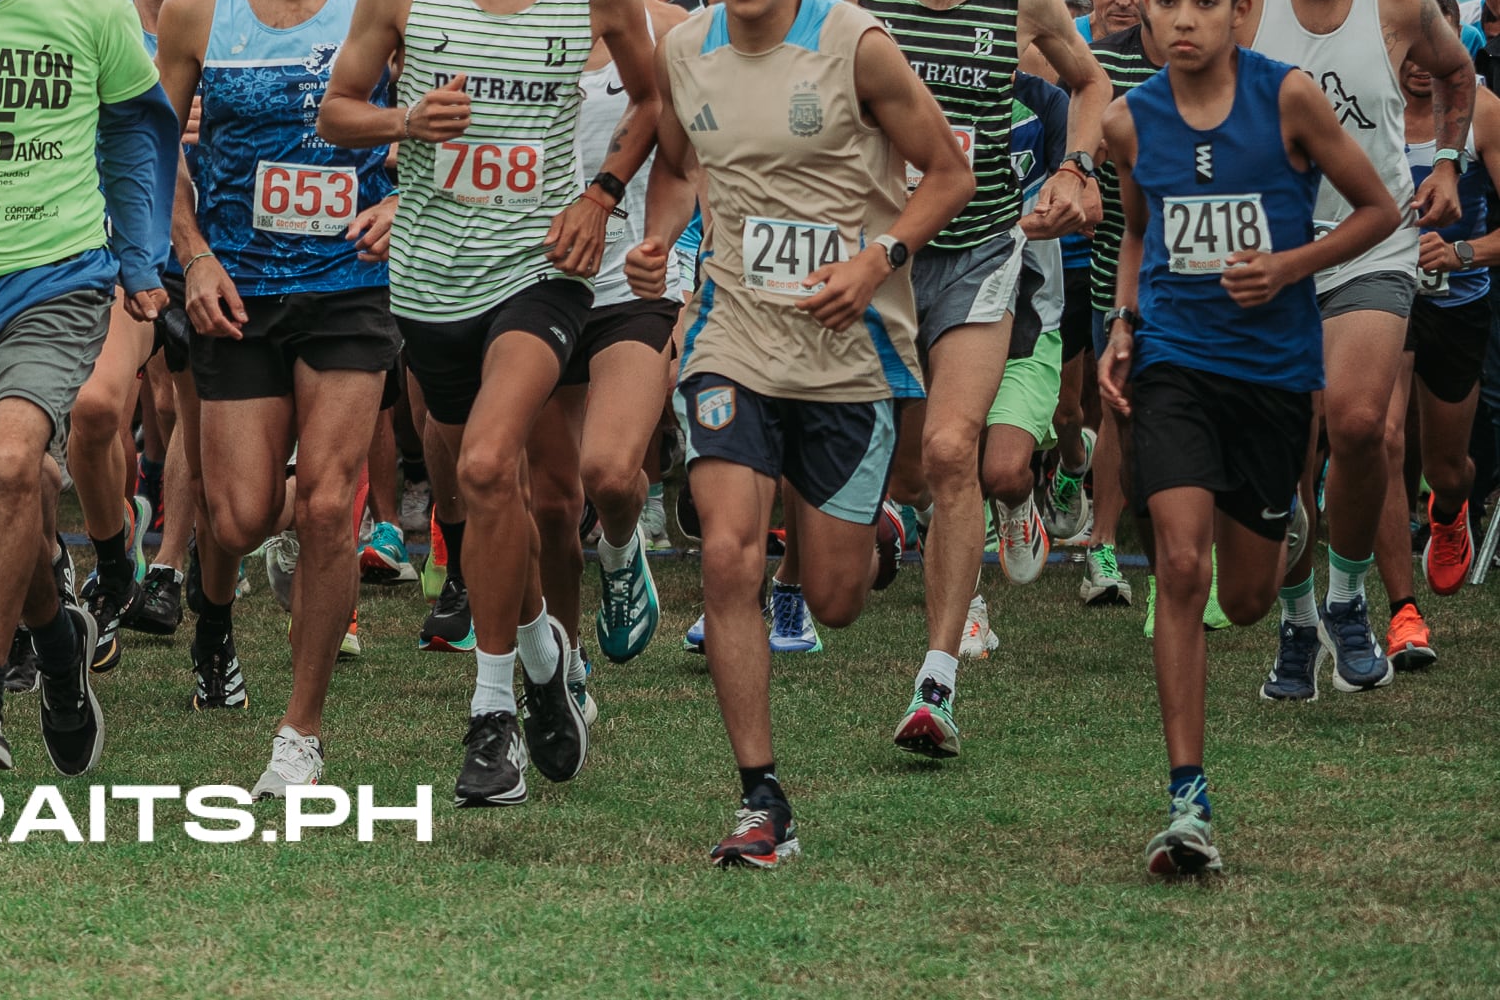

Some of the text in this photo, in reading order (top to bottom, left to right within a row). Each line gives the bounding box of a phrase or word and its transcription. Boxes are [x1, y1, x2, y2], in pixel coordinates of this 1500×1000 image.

[298, 82, 317, 91] SON
[14, 138, 64, 162] AÑOS
[441, 142, 538, 194] 768
[261, 167, 354, 219] 653
[751, 222, 840, 276] 2414
[1169, 200, 1262, 255] 2418
